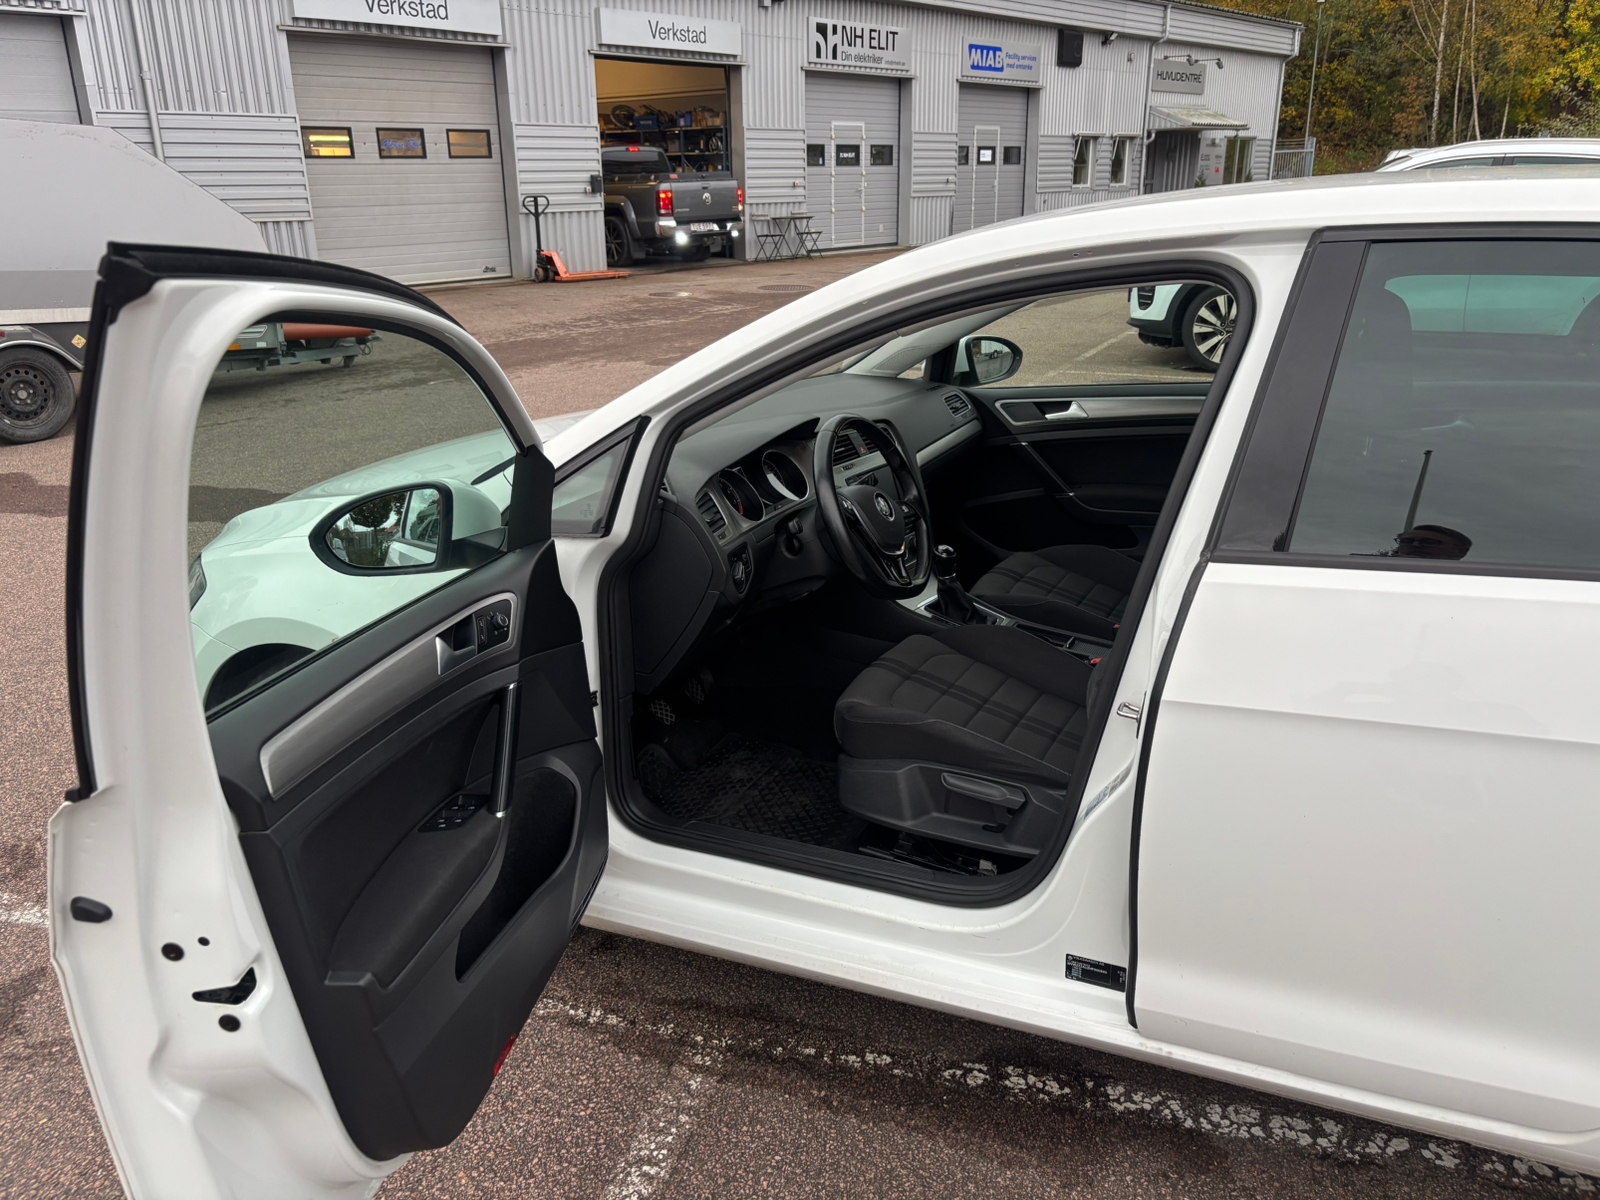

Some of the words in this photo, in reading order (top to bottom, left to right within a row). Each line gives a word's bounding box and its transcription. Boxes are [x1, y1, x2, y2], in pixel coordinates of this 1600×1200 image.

[365, 0, 449, 20] Verkstad
[648, 20, 707, 44] Verkstad
[841, 25, 864, 48] NH
[869, 28, 899, 51] ELIT
[841, 51, 853, 62] Din
[854, 52, 884, 65] elektriker
[970, 48, 1003, 68] MIAB
[1005, 52, 1020, 62] Facility
[1157, 70, 1203, 84] HUVUDENTRÉ
